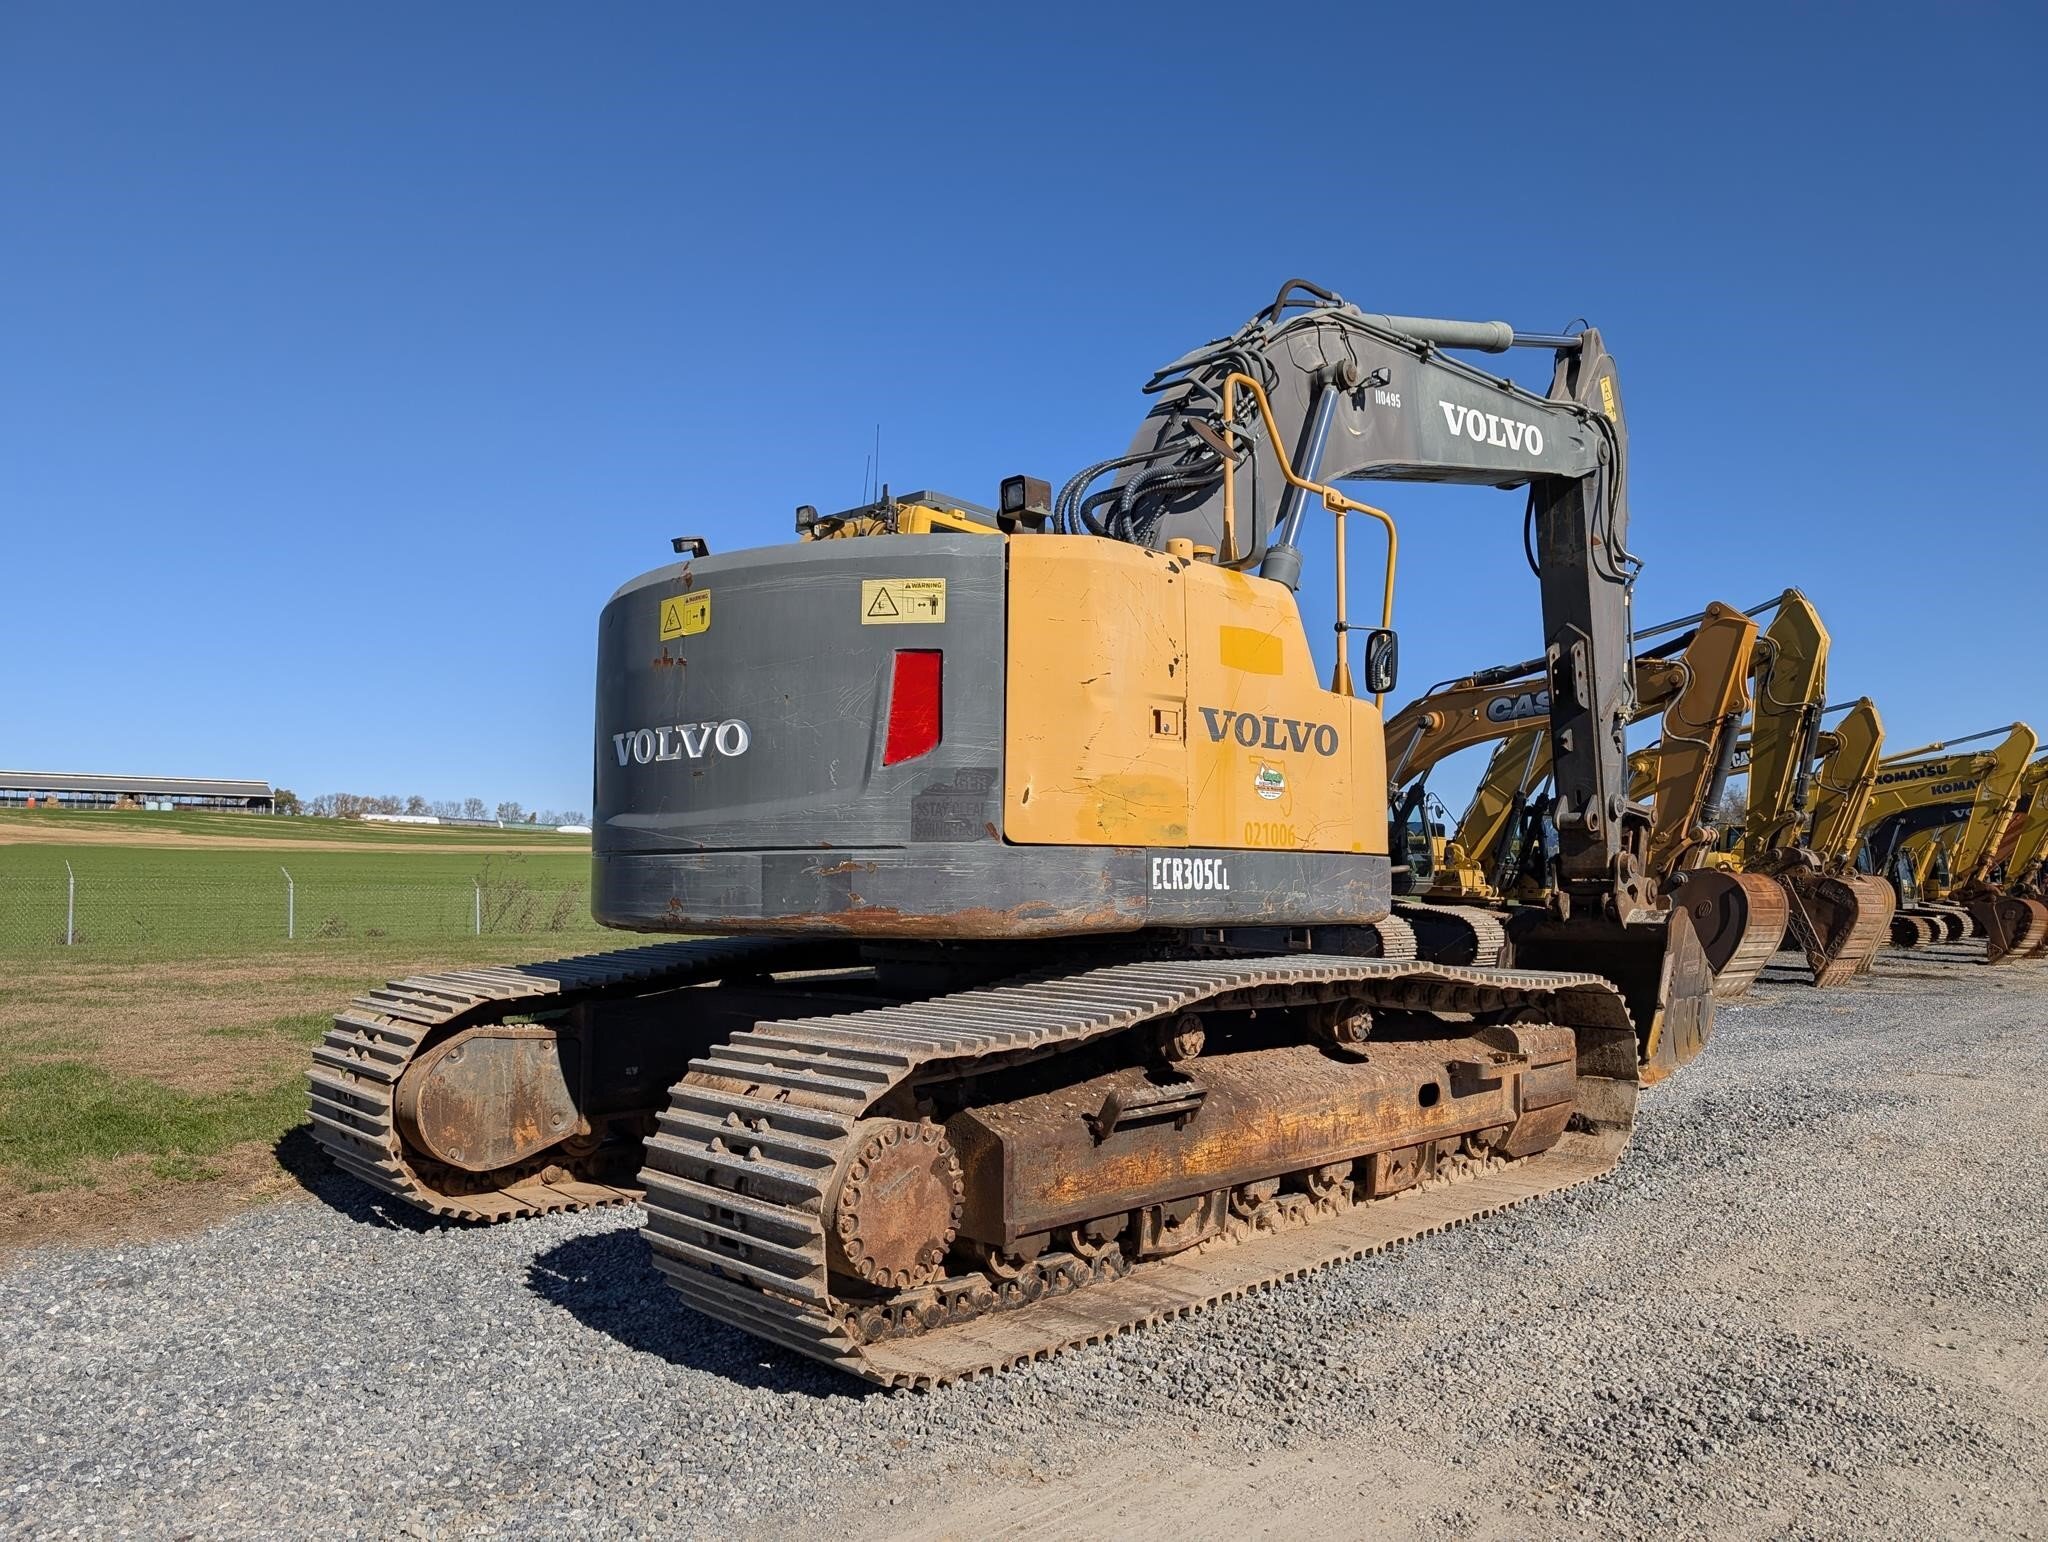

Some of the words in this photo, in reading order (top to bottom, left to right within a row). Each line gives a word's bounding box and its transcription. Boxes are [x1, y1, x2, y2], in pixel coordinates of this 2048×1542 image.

[1375, 389, 1401, 409] 110495
[1439, 400, 1544, 456] VOLVO
[612, 718, 752, 767] VOLVO
[1199, 706, 1339, 757] VOLVO
[1732, 750, 1750, 767] CA
[1875, 764, 1948, 785] KOMATSU
[1245, 822, 1296, 847] 021006
[1152, 857, 1230, 890] ECR305CL
